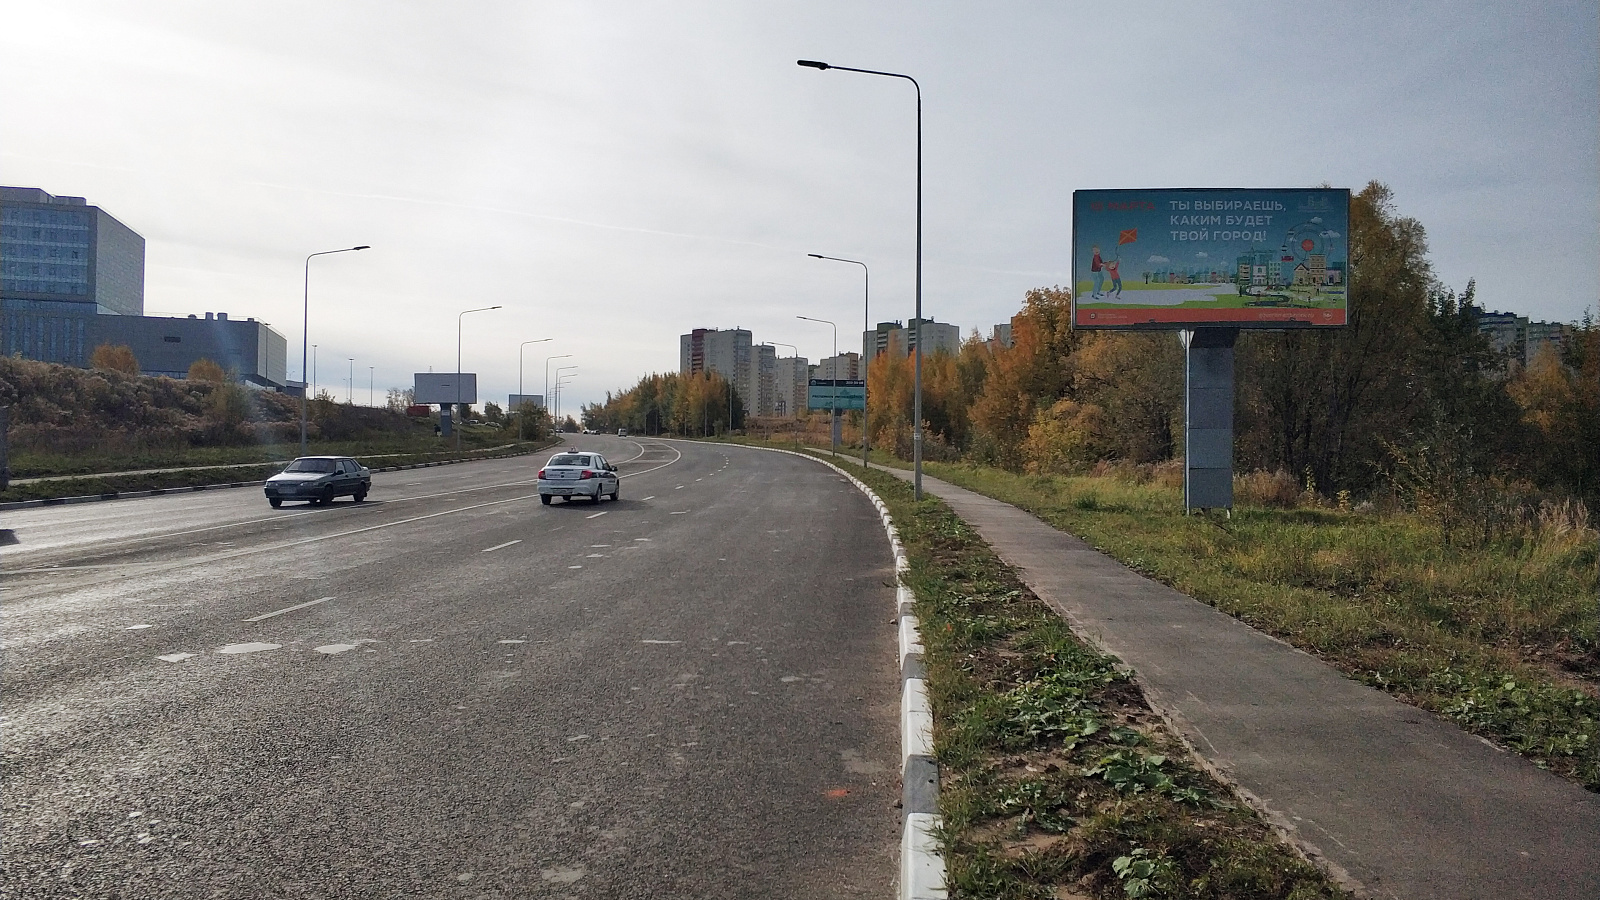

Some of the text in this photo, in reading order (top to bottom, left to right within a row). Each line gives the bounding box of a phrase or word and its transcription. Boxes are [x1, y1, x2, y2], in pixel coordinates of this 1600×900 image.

[1169, 200, 1190, 211] ТЫ
[1194, 200, 1286, 212] ВЫБИРАЕШЬ,
[1170, 215, 1273, 227] КАКИМ БУДЕТ
[1170, 228, 1267, 243] ТВОЙ ГОРОД!
